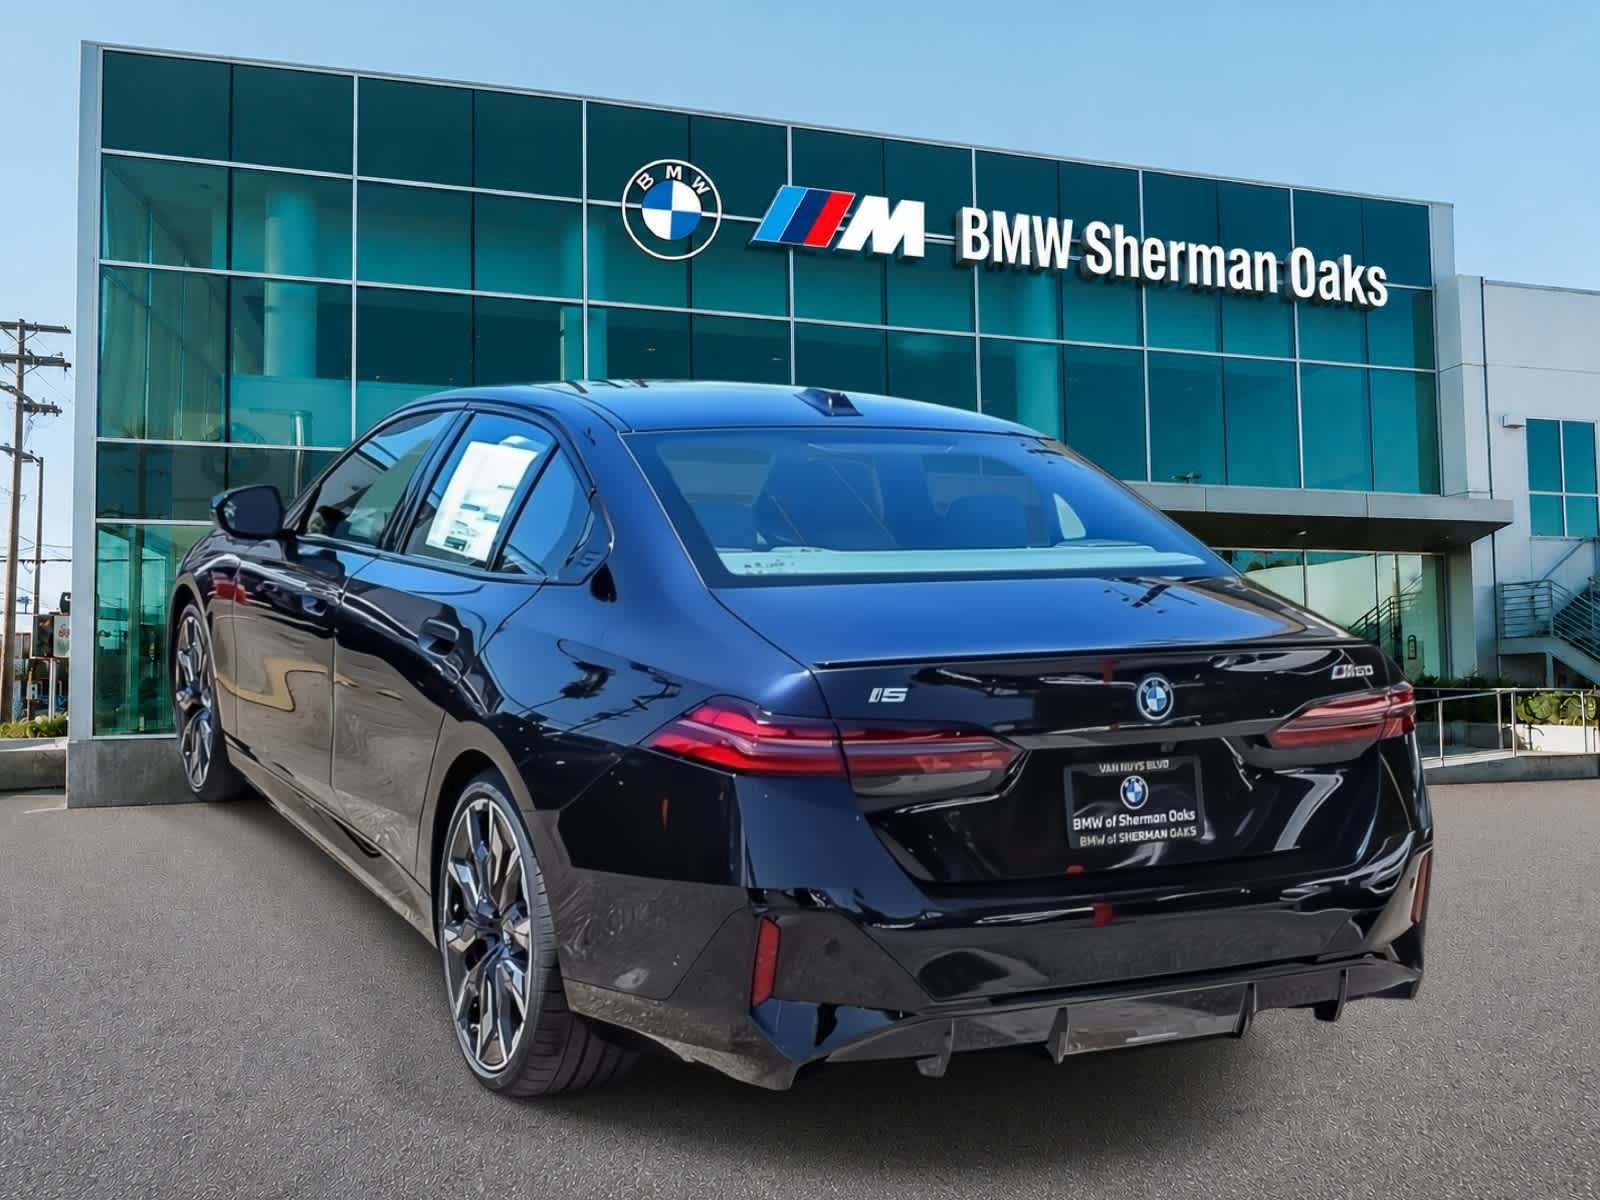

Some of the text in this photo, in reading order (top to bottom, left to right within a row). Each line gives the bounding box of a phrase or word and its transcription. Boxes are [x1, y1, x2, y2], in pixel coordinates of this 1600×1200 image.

[636, 165, 711, 195] BMW
[835, 194, 926, 258] M
[960, 206, 1388, 308] BMW Sherman Oaks
[1100, 762, 1119, 773] VAN
[1146, 759, 1169, 770] BLVD
[1073, 809, 1196, 831] BMW of Sherman Oaks
[1079, 826, 1197, 847] BMW of SHERMAN OAKS
